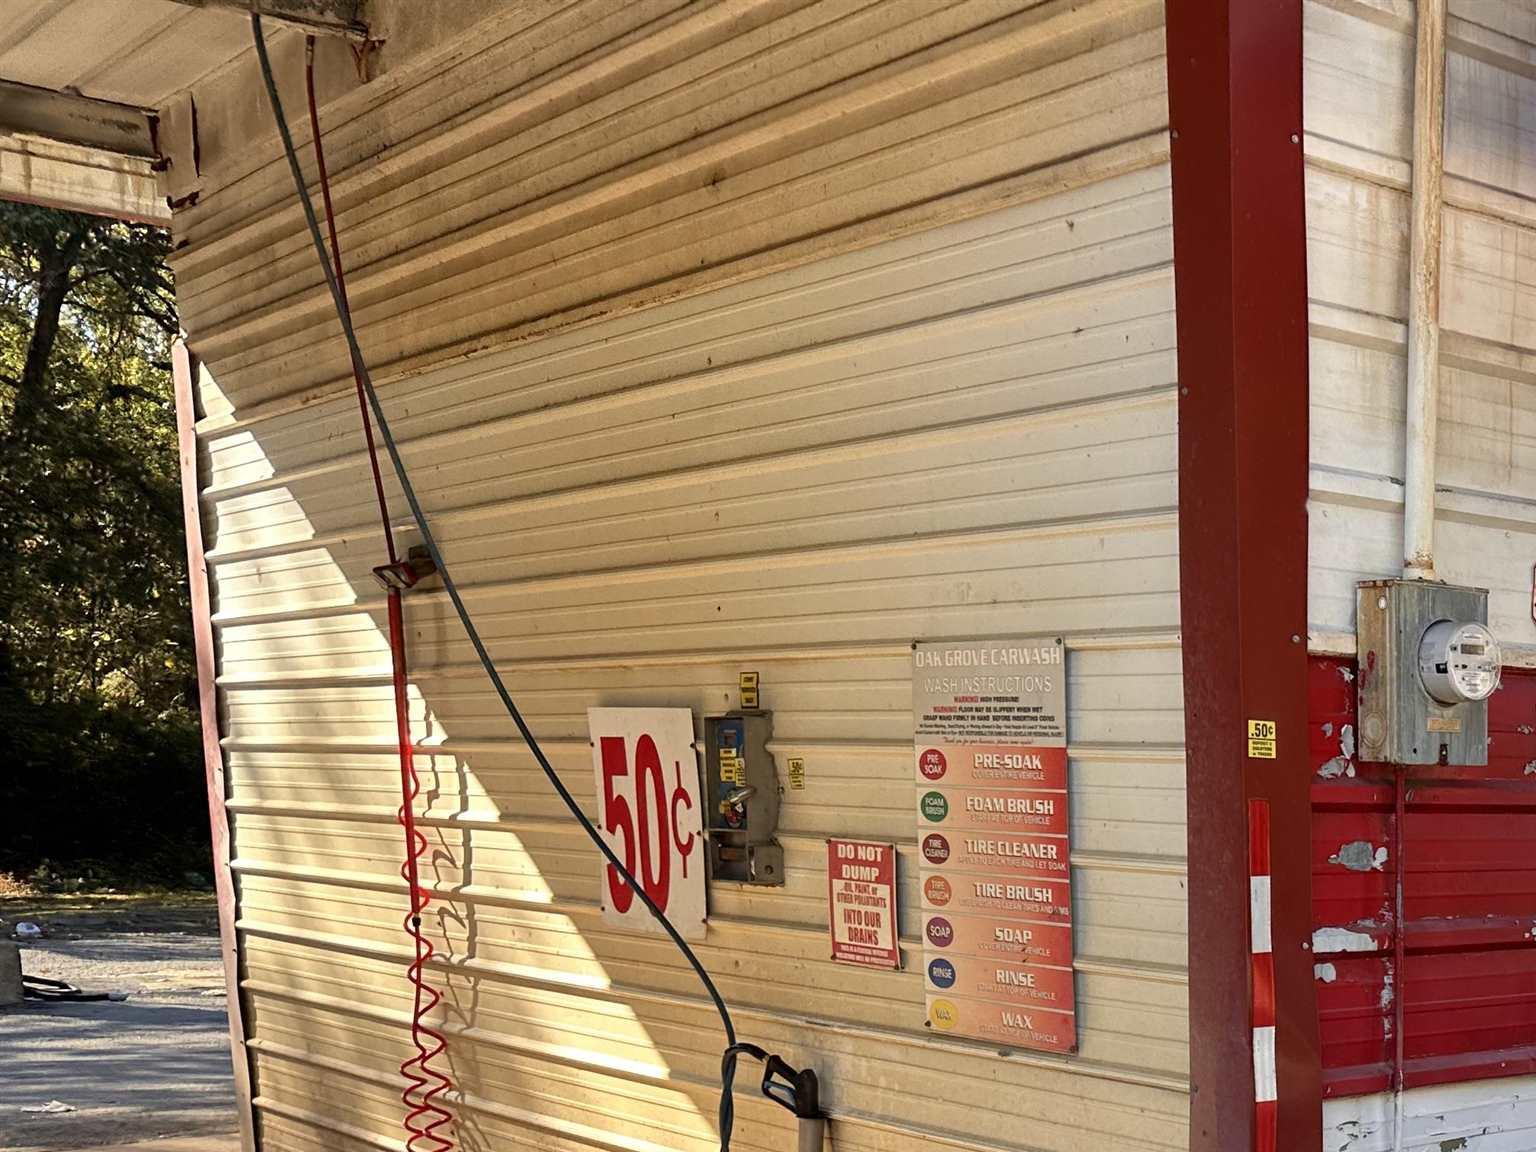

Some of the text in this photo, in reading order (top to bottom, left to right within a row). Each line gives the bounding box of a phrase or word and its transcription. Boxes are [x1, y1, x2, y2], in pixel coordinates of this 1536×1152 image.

[915, 647, 1061, 668] OAK GROVE CARWASH
[924, 675, 1052, 693] WASH INSTRUCTIONS
[1251, 723, 1273, 737] .50¢
[924, 765, 943, 775] SOAK
[973, 753, 1042, 770] PRE-SOAK
[925, 798, 945, 807] FOAM
[966, 796, 1054, 815] FOAM BRUSH
[600, 733, 694, 917] 50¢
[929, 839, 942, 848] TIRE
[965, 838, 997, 855] TIRE
[997, 842, 1057, 860] CLEANER
[837, 844, 883, 862] DO NOT
[842, 864, 879, 881] DUMP
[1035, 860, 1047, 869] LET
[974, 881, 1005, 899] TIRE
[1007, 885, 1053, 903] BRUSH
[844, 909, 881, 928] INTO OUR
[848, 926, 879, 946] DRAINS
[930, 925, 951, 938] SOAP
[993, 927, 1033, 944] SOAP
[932, 966, 953, 979] RINSE
[996, 969, 1035, 987] RINSE
[1001, 1011, 1034, 1029] WAX
